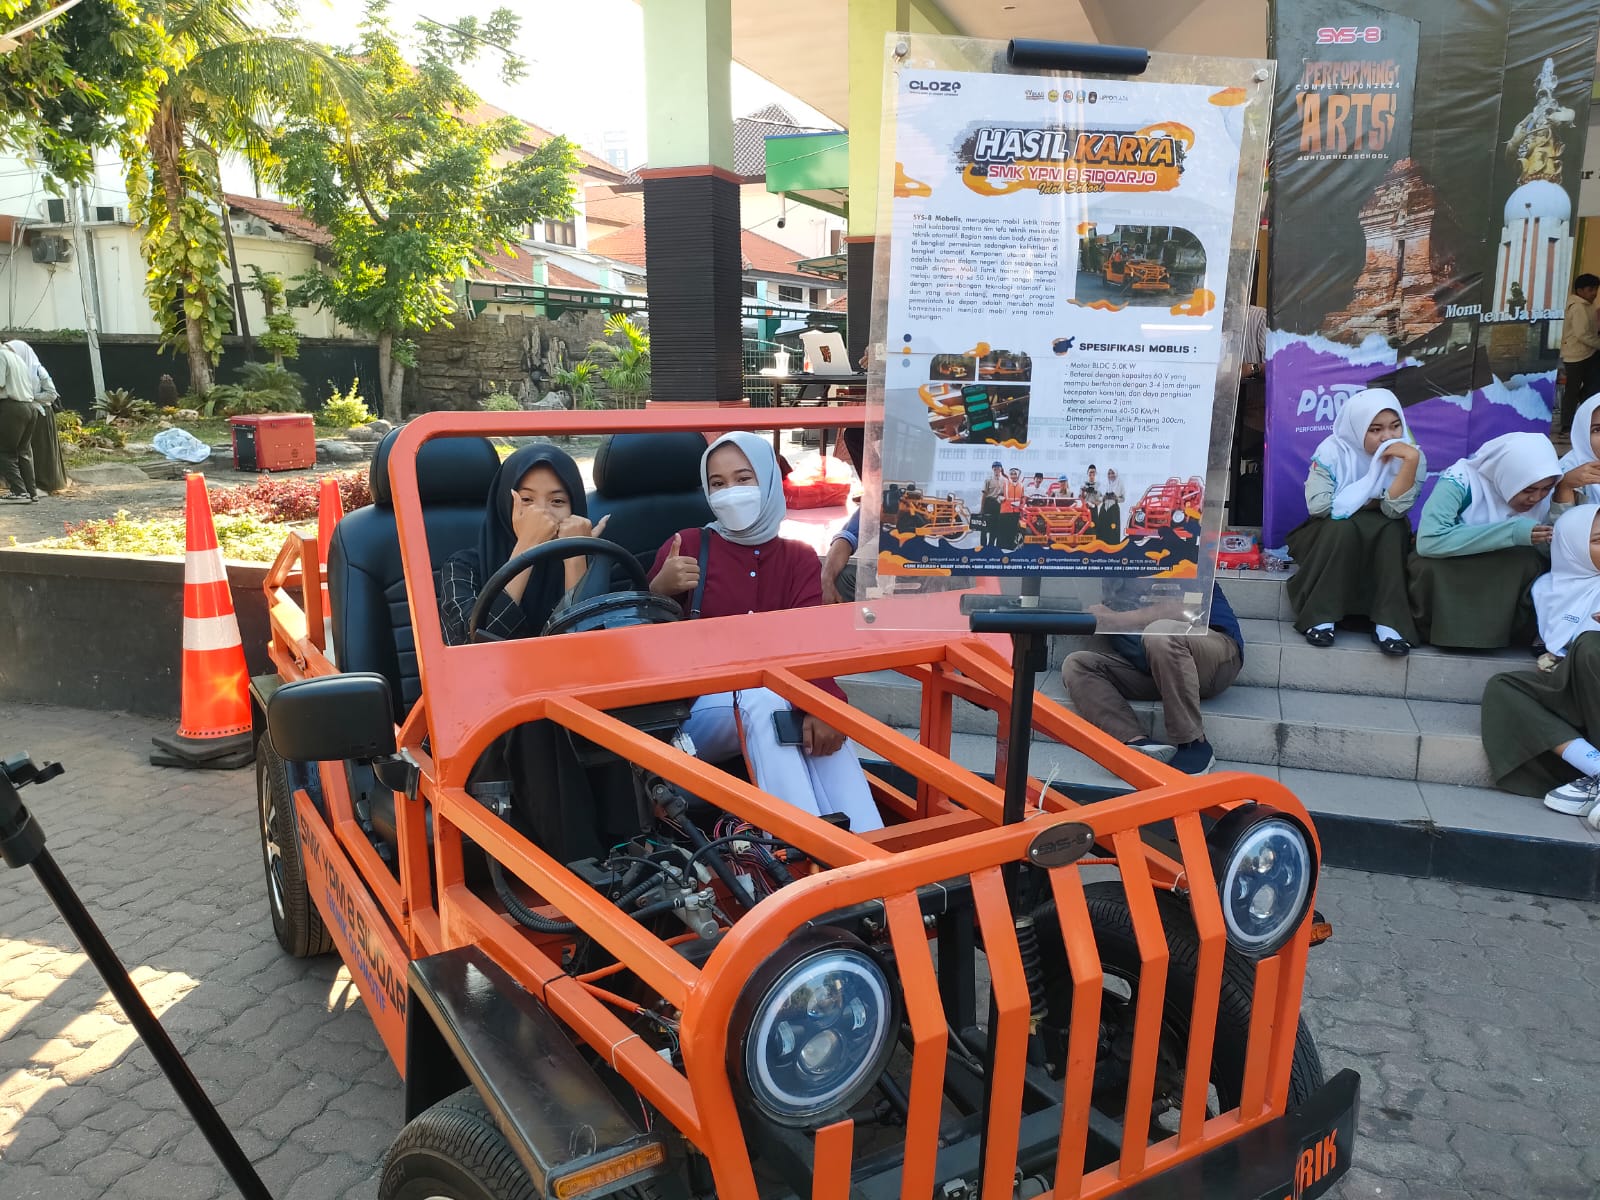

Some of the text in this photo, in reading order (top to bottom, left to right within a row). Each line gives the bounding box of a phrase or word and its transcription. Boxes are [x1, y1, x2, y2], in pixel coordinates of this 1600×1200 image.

[1316, 26, 1381, 44] SYS-8
[974, 127, 1177, 167] HASIL KARYA
[988, 164, 1156, 185] SMK YPM 8 SIDOARJO
[1066, 181, 1105, 194] School
[1079, 343, 1189, 354] SPESIFIKASI MOBLIS
[300, 814, 323, 872] SMK
